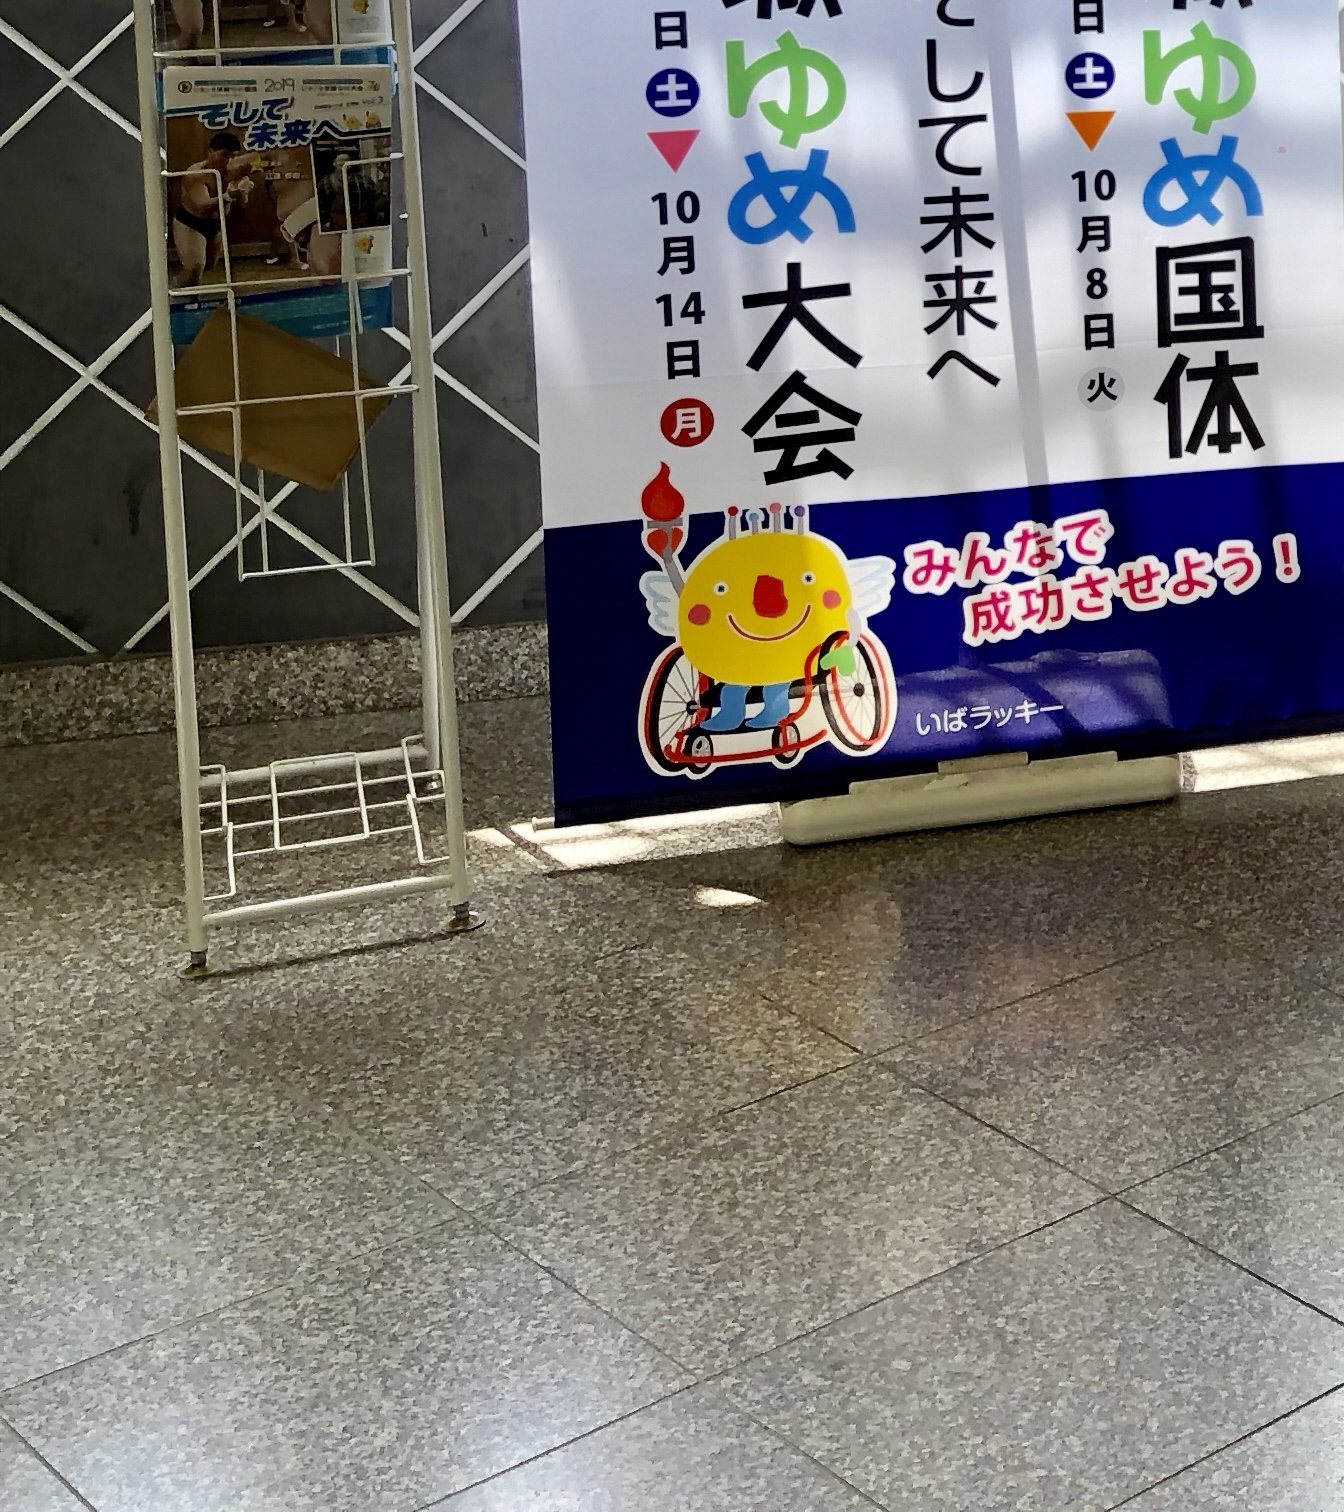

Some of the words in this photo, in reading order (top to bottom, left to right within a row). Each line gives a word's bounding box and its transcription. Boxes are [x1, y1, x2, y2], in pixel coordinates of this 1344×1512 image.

[264, 78, 295, 93] 2019
[200, 97, 292, 128] そして
[245, 120, 342, 149] 未来へ
[904, 511, 1114, 593] みんなで
[914, 699, 1065, 737] いばラッキー
